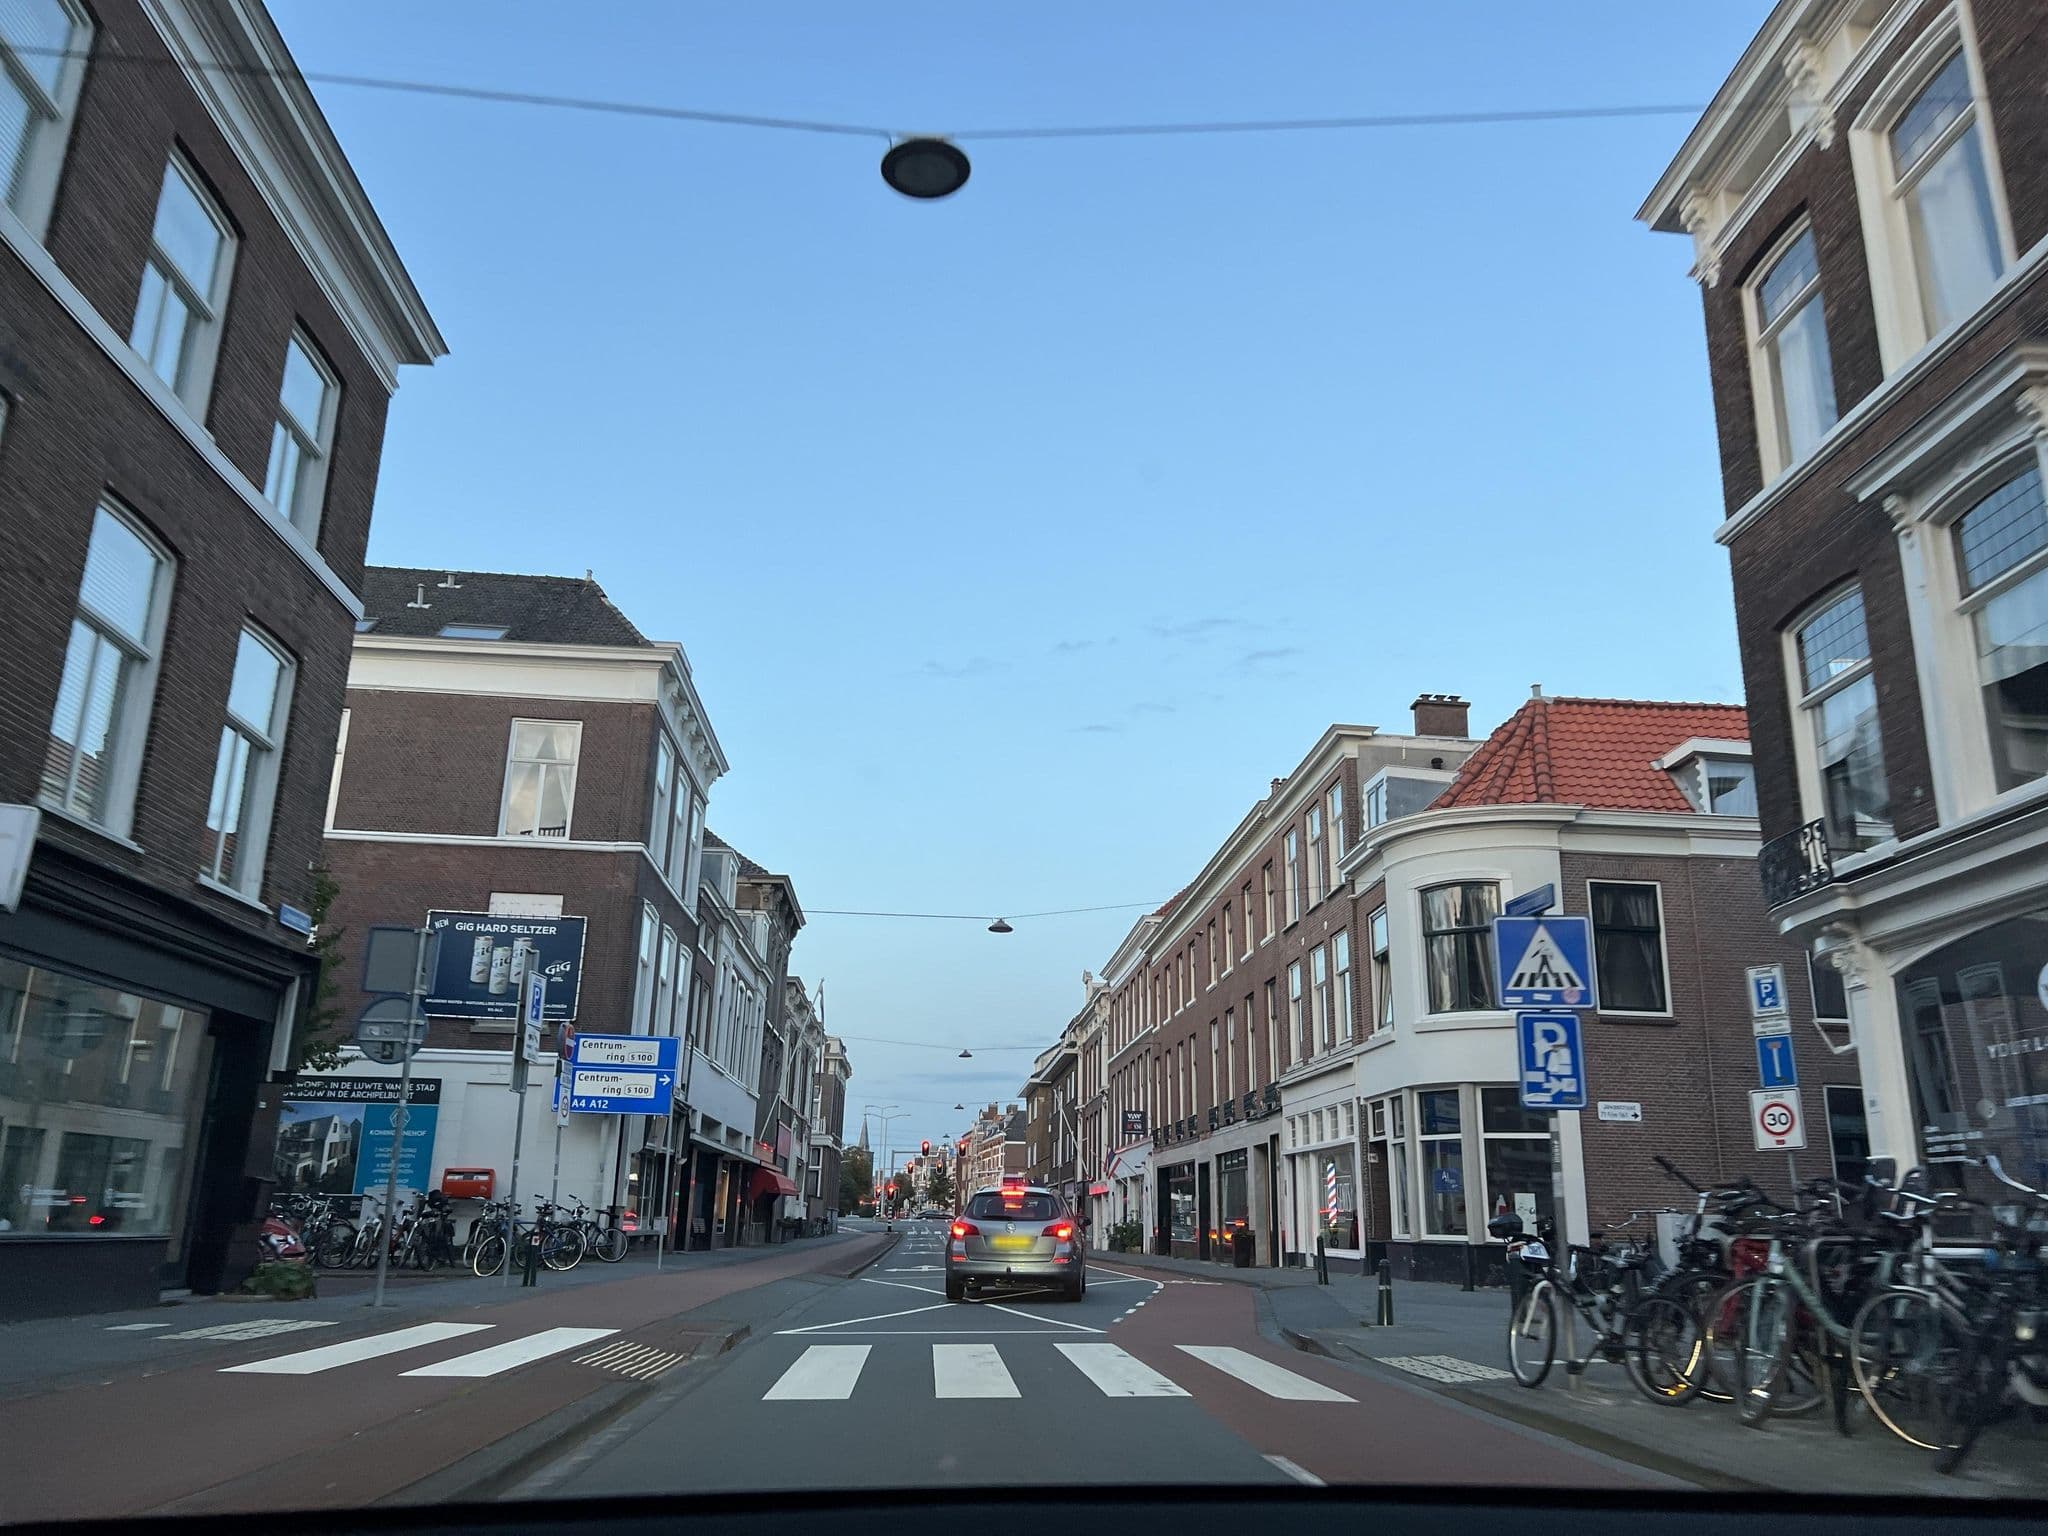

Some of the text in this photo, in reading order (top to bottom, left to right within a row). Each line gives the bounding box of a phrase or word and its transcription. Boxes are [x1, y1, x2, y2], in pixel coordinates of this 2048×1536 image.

[434, 918, 449, 929] NEW
[455, 922, 557, 935] GiG HARD SELTZER
[582, 1040, 627, 1050] Centrum-
[606, 1053, 625, 1063] ring
[638, 1054, 653, 1062] 100
[578, 1072, 623, 1082] Centrum-
[330, 1081, 340, 1089] IN
[340, 1082, 352, 1090] DE
[353, 1082, 383, 1090] LUWTE
[385, 1083, 401, 1091] VAN
[416, 1084, 436, 1092] STAD
[602, 1086, 649, 1096] ring S 100
[572, 1099, 609, 1109] A4 A12
[1767, 1112, 1789, 1126] 30
